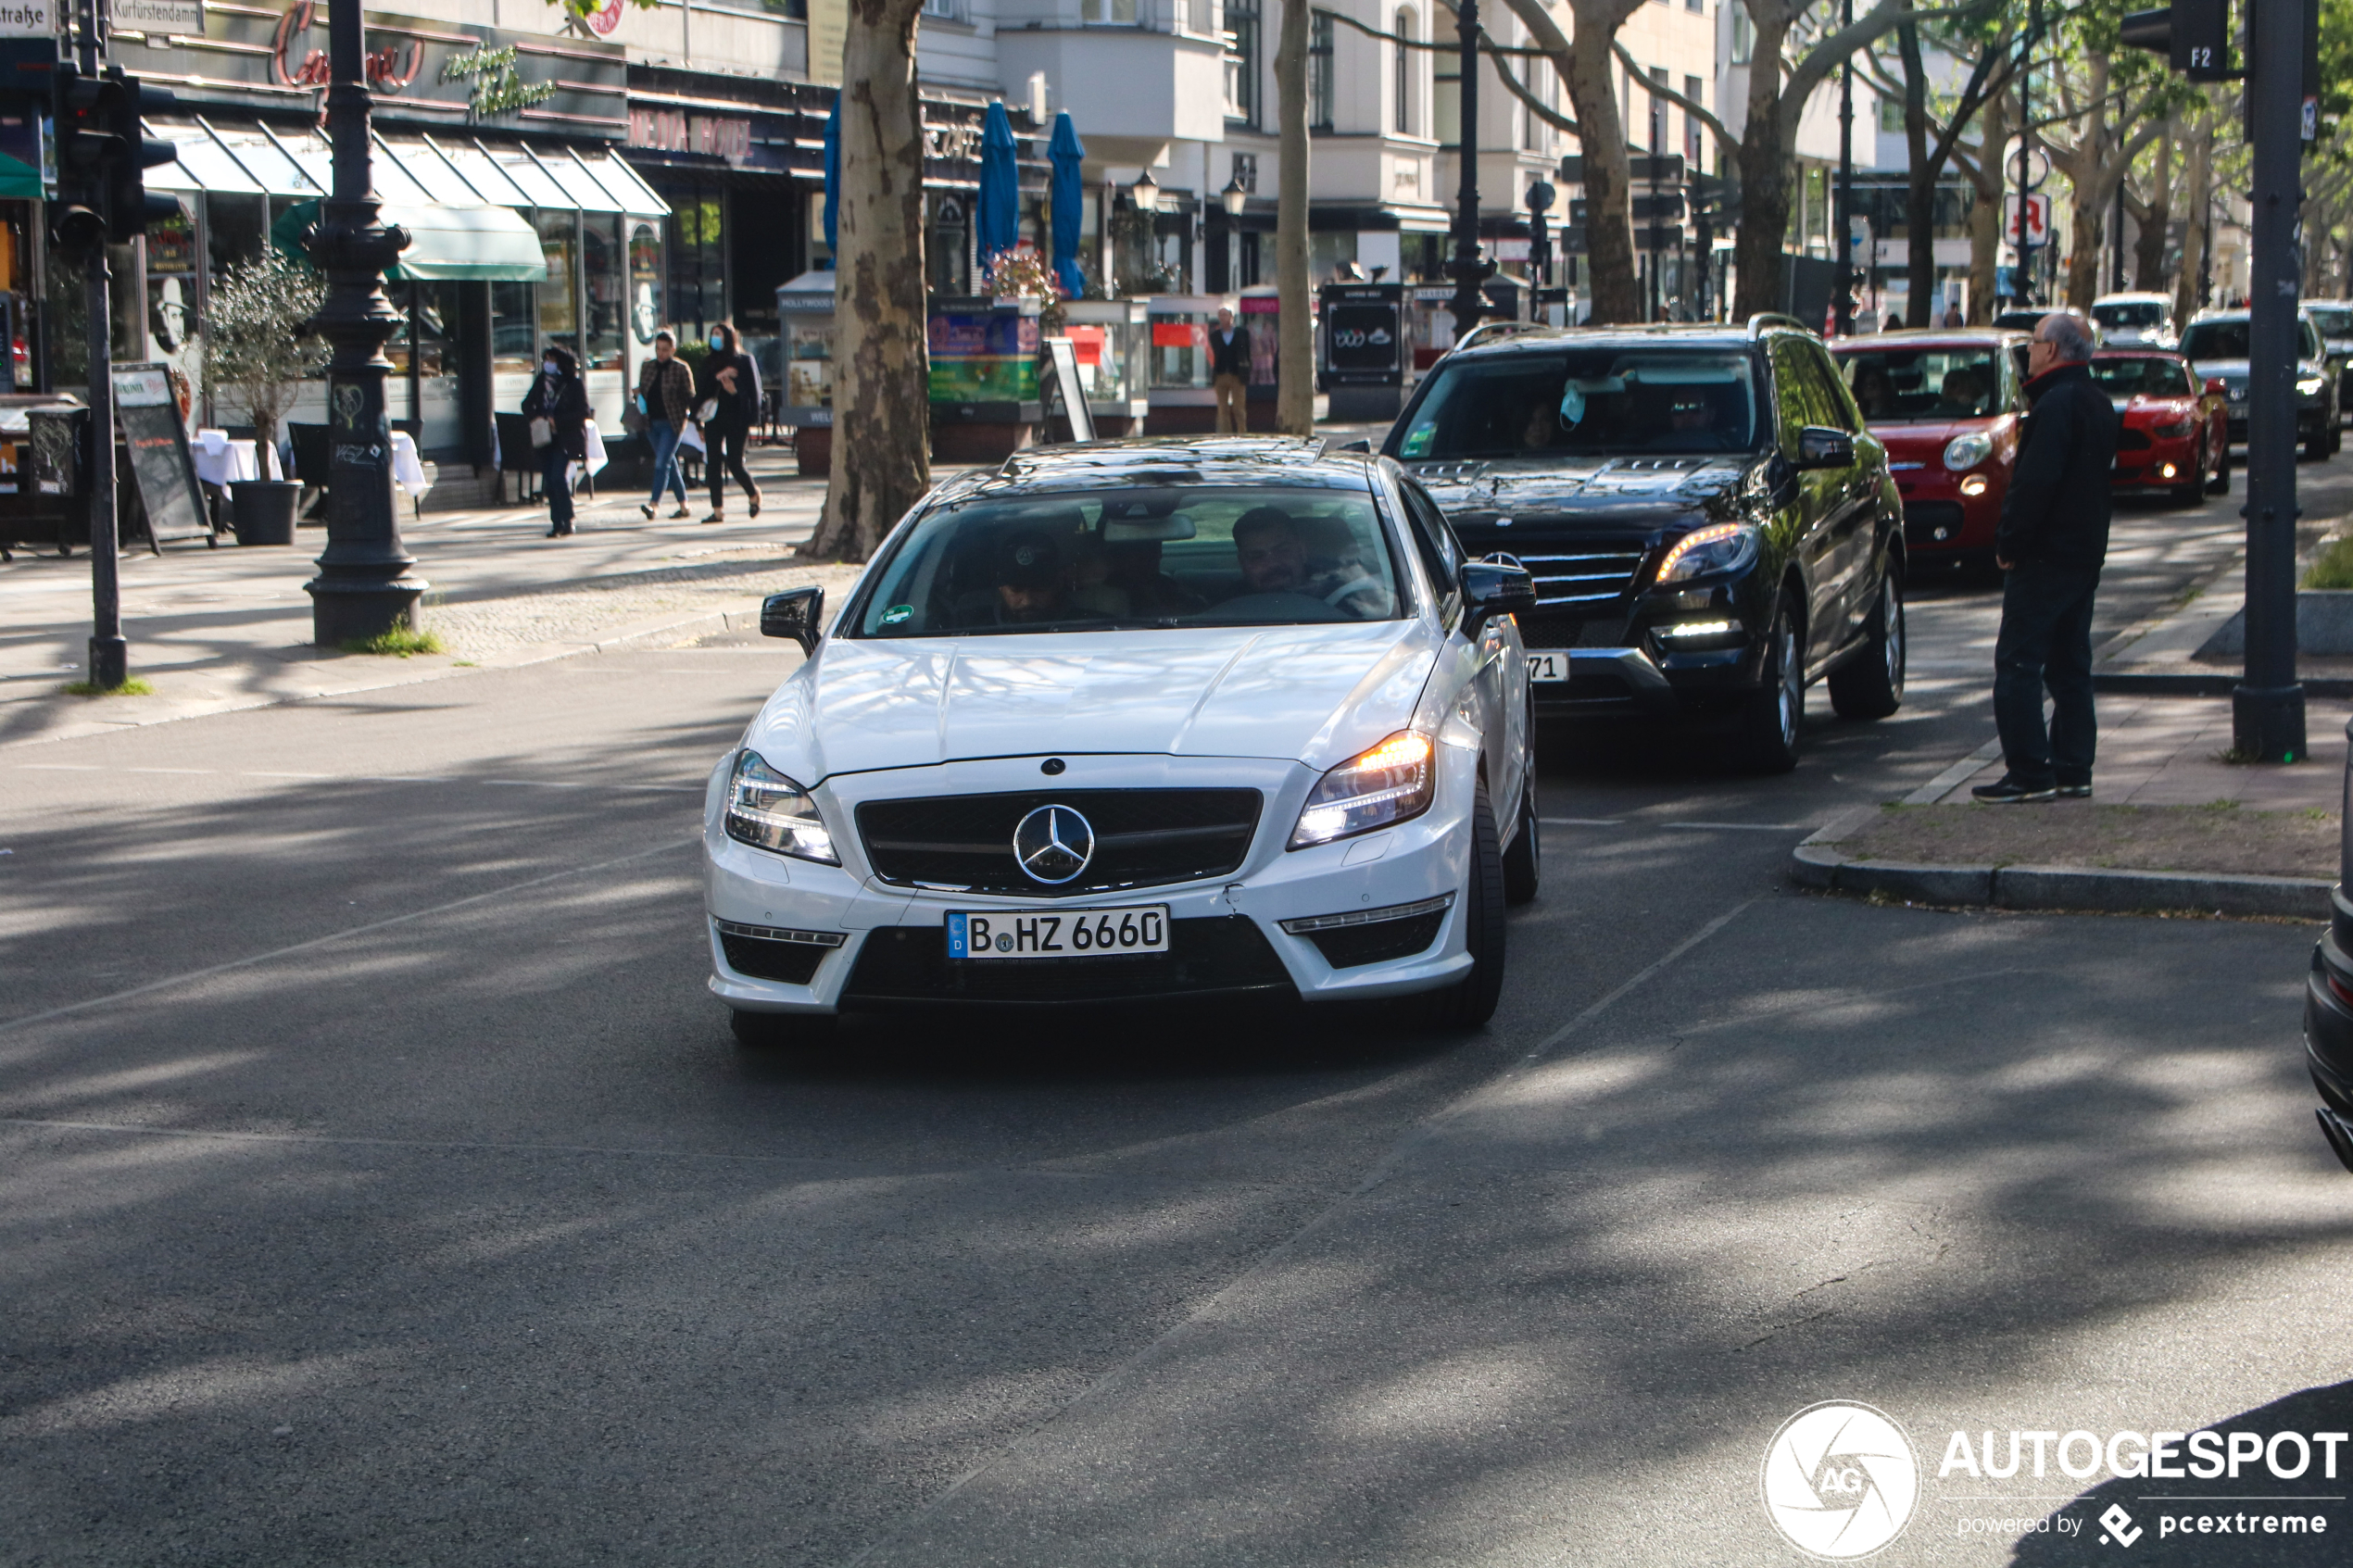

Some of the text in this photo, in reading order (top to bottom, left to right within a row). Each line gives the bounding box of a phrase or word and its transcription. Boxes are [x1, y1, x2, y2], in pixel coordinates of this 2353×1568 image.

[0, 5, 44, 29] traße
[114, 0, 198, 23] Kurfürstendamm
[2191, 47, 2211, 68] F2
[629, 108, 755, 157] MEDIA HOTEL
[782, 298, 830, 308] HOLLYWOOD
[1529, 657, 1556, 678] 71
[971, 911, 1162, 952] B HZ 6660
[954, 940, 962, 950] D
